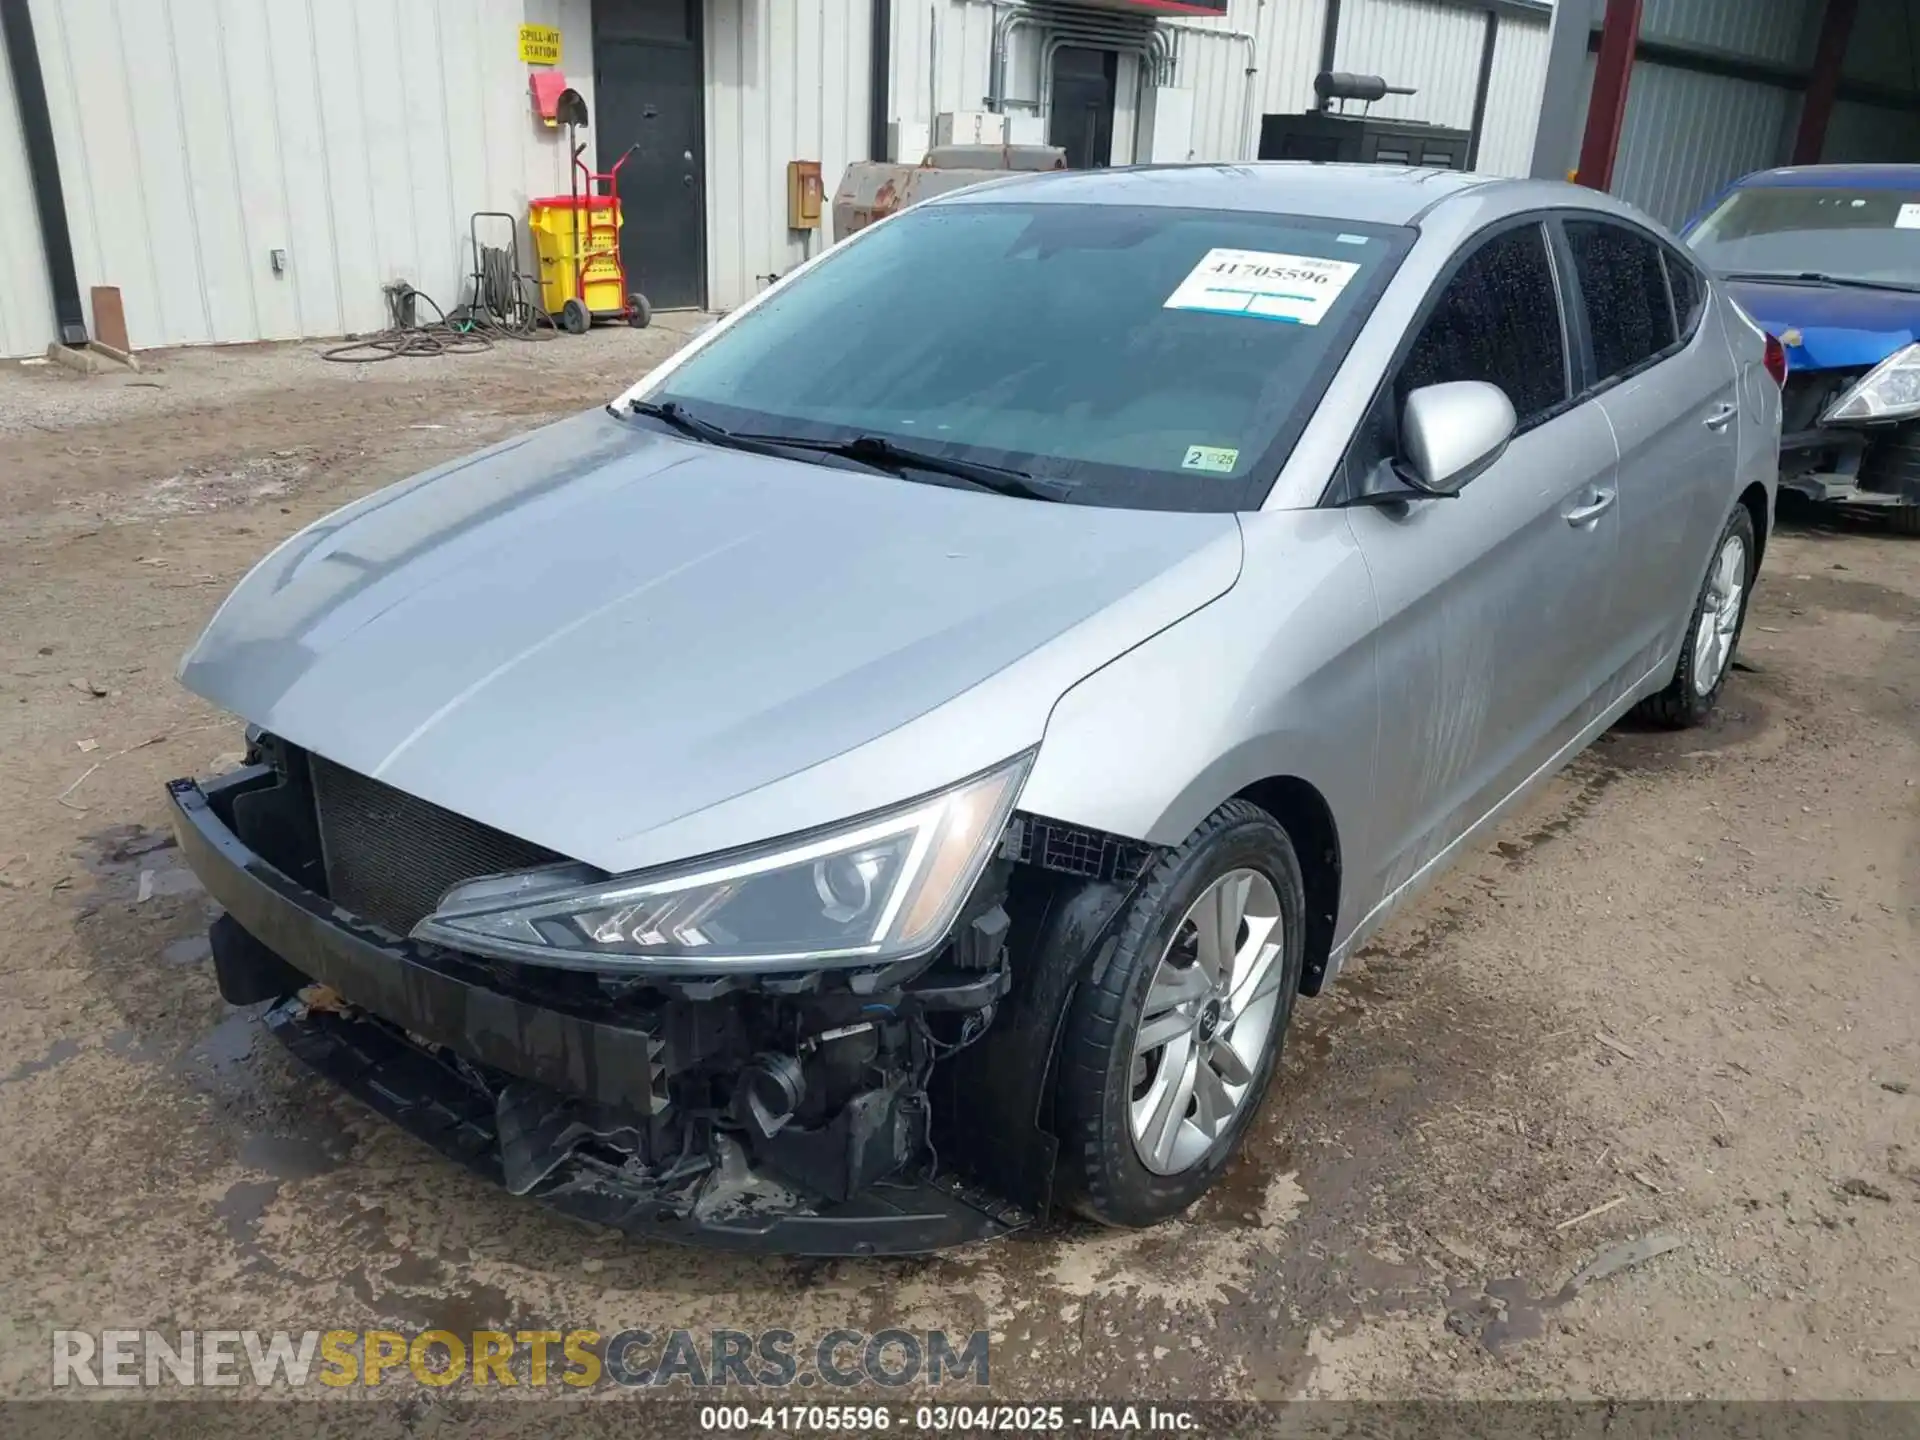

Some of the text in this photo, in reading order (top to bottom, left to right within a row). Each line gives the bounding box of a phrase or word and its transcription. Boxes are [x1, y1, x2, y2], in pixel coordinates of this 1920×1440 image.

[523, 45, 558, 58] STATION
[1209, 263, 1329, 284] 41705596
[1188, 451, 1202, 465] 2
